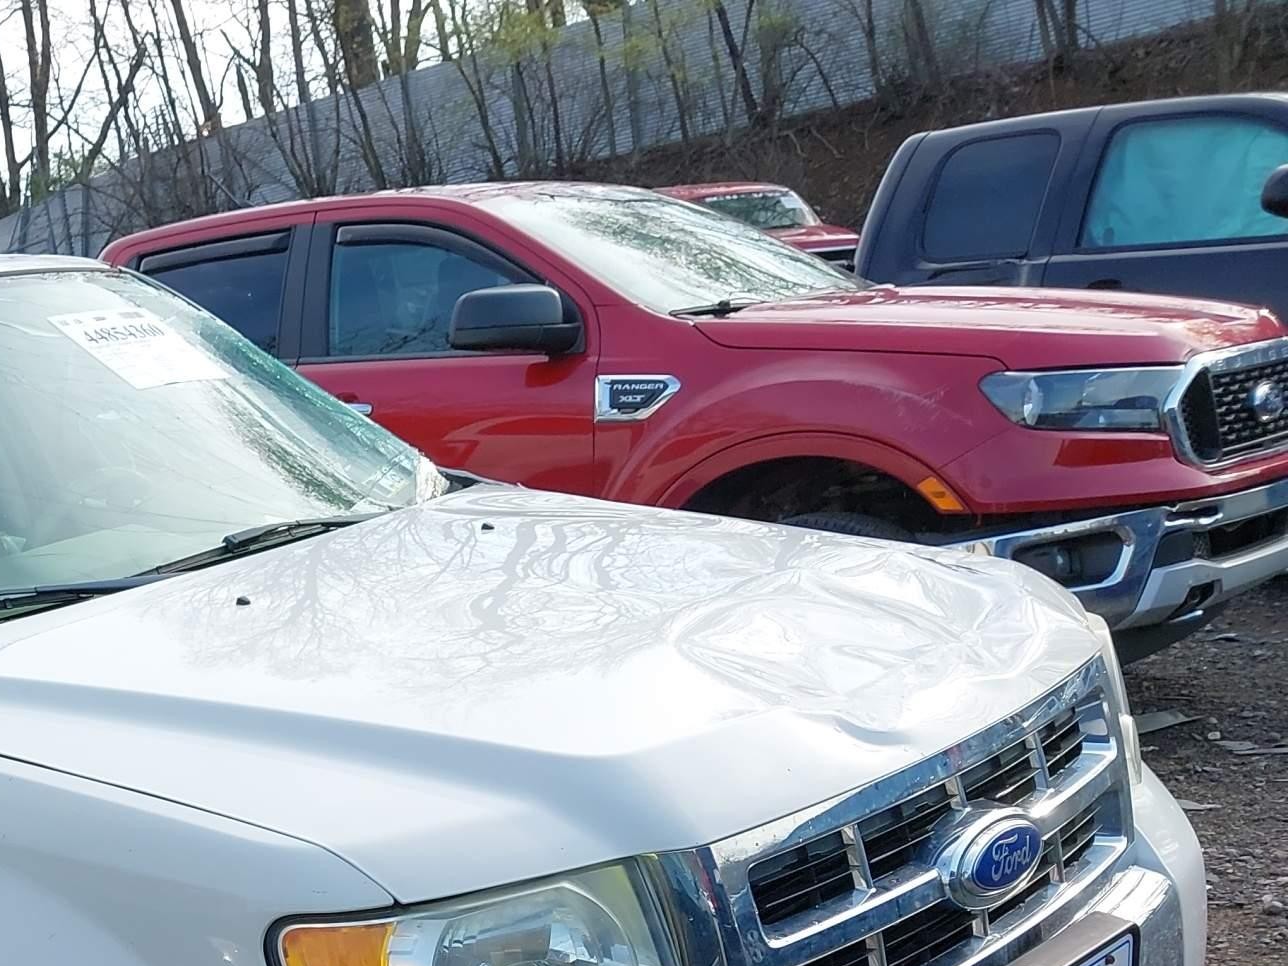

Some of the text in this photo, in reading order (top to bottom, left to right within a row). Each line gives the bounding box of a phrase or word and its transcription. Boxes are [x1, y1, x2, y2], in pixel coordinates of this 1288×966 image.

[83, 322, 165, 344] 44854360
[612, 383, 664, 391] RANGER
[618, 395, 645, 403] XLT
[992, 833, 1032, 881] Ford
